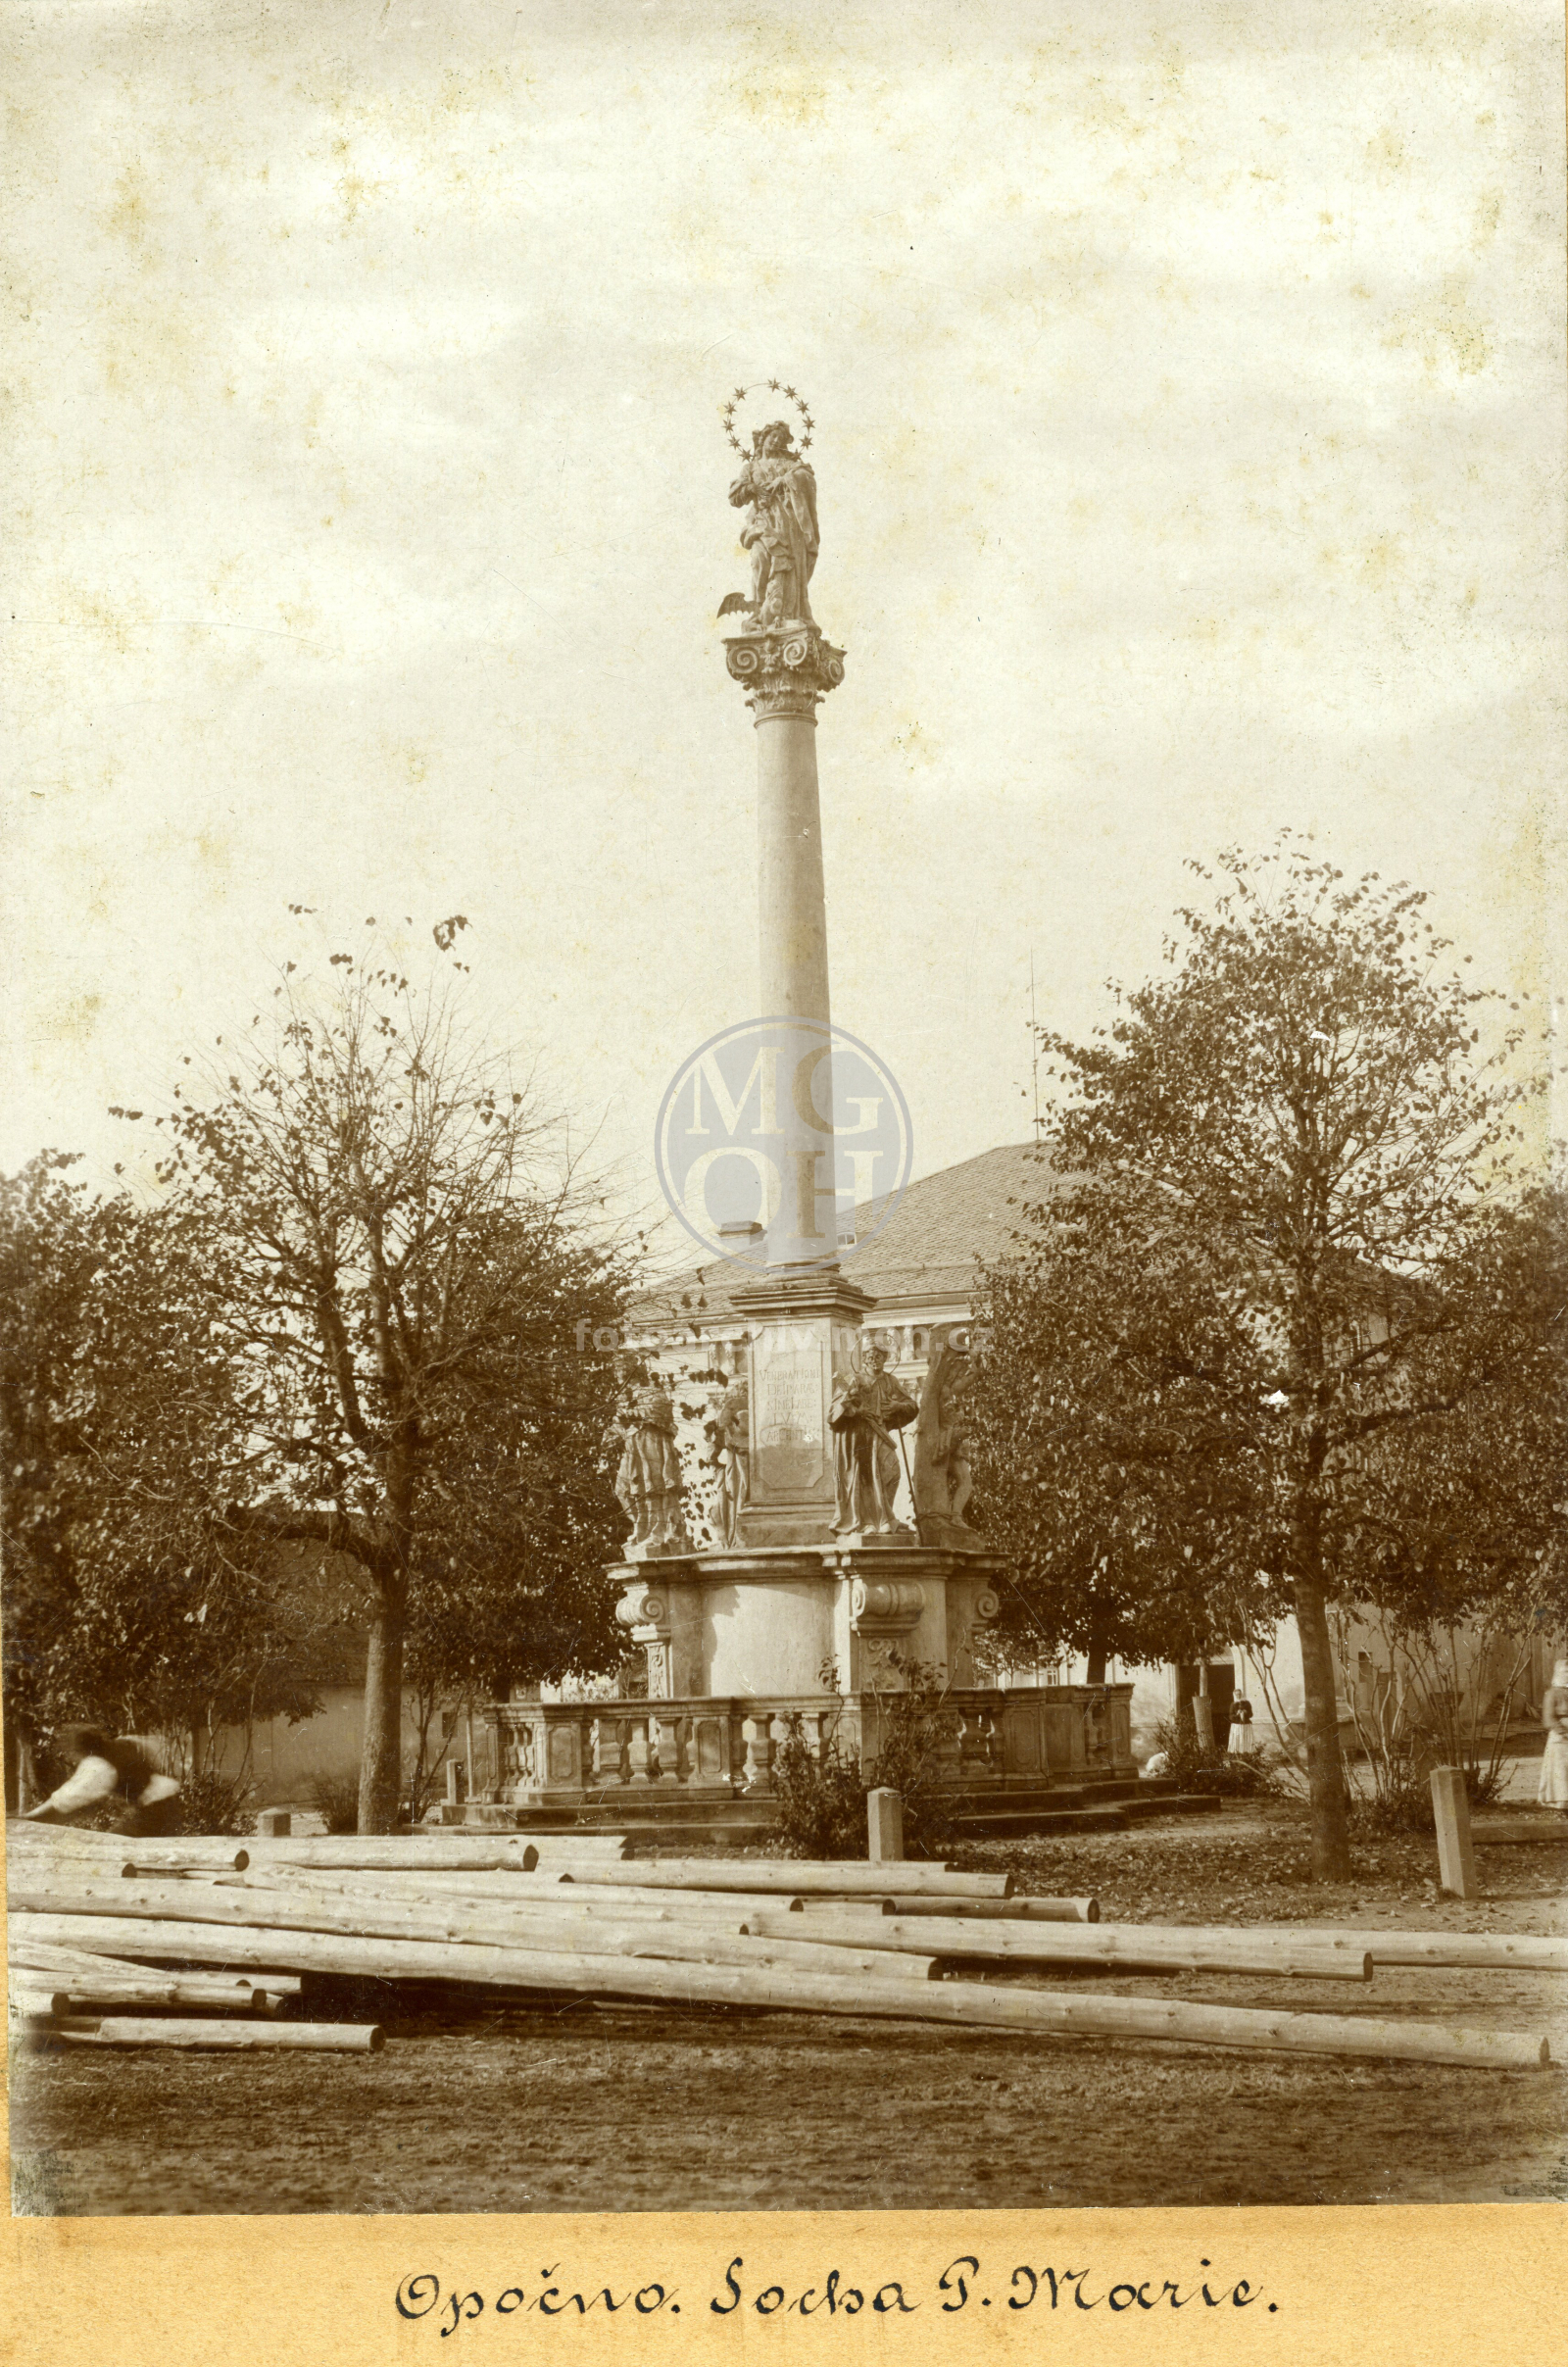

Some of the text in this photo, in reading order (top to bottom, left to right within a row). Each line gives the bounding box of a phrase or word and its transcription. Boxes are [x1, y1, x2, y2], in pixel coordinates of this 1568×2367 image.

[394, 2263, 682, 2339] Opočno.
[710, 2256, 920, 2316] Socha
[1007, 2258, 1280, 2314] Marie.
